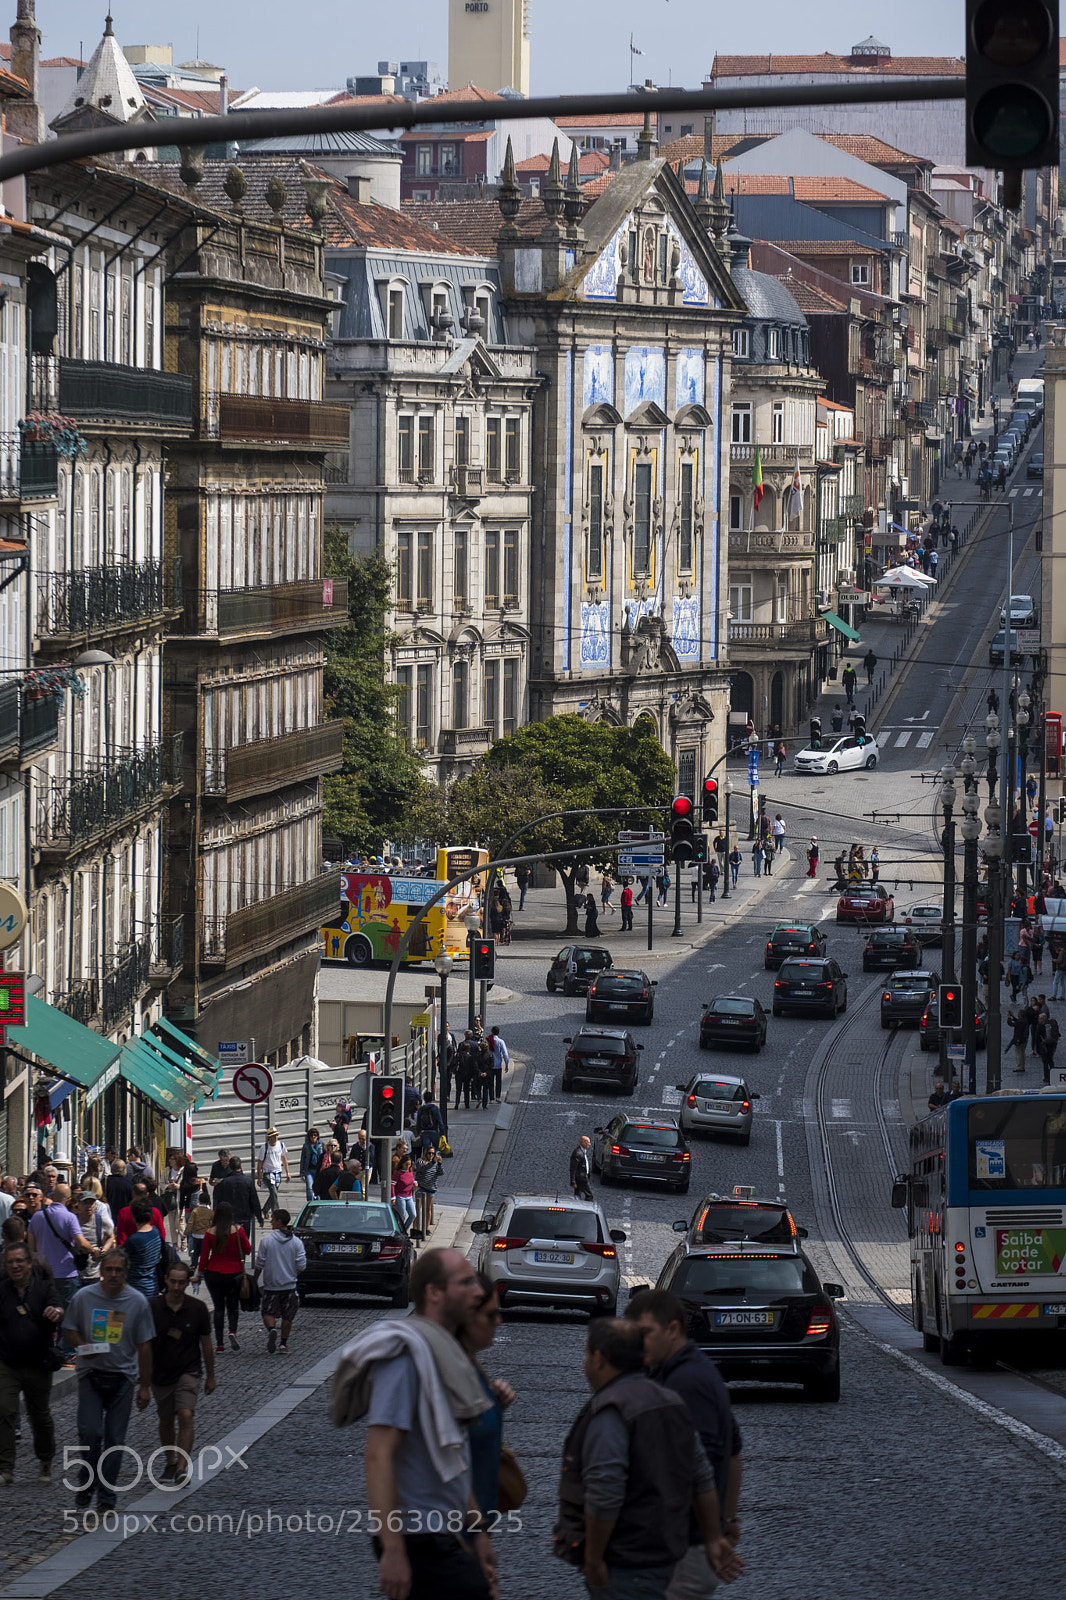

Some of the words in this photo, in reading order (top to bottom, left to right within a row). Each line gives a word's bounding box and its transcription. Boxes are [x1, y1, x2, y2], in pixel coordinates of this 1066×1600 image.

[465, 2, 489, 13] PORTO
[1001, 1233, 1043, 1246] Saiba
[1001, 1246, 1038, 1258] onde
[1002, 1259, 1043, 1270] votar
[722, 1313, 767, 1323] 71-ON-63
